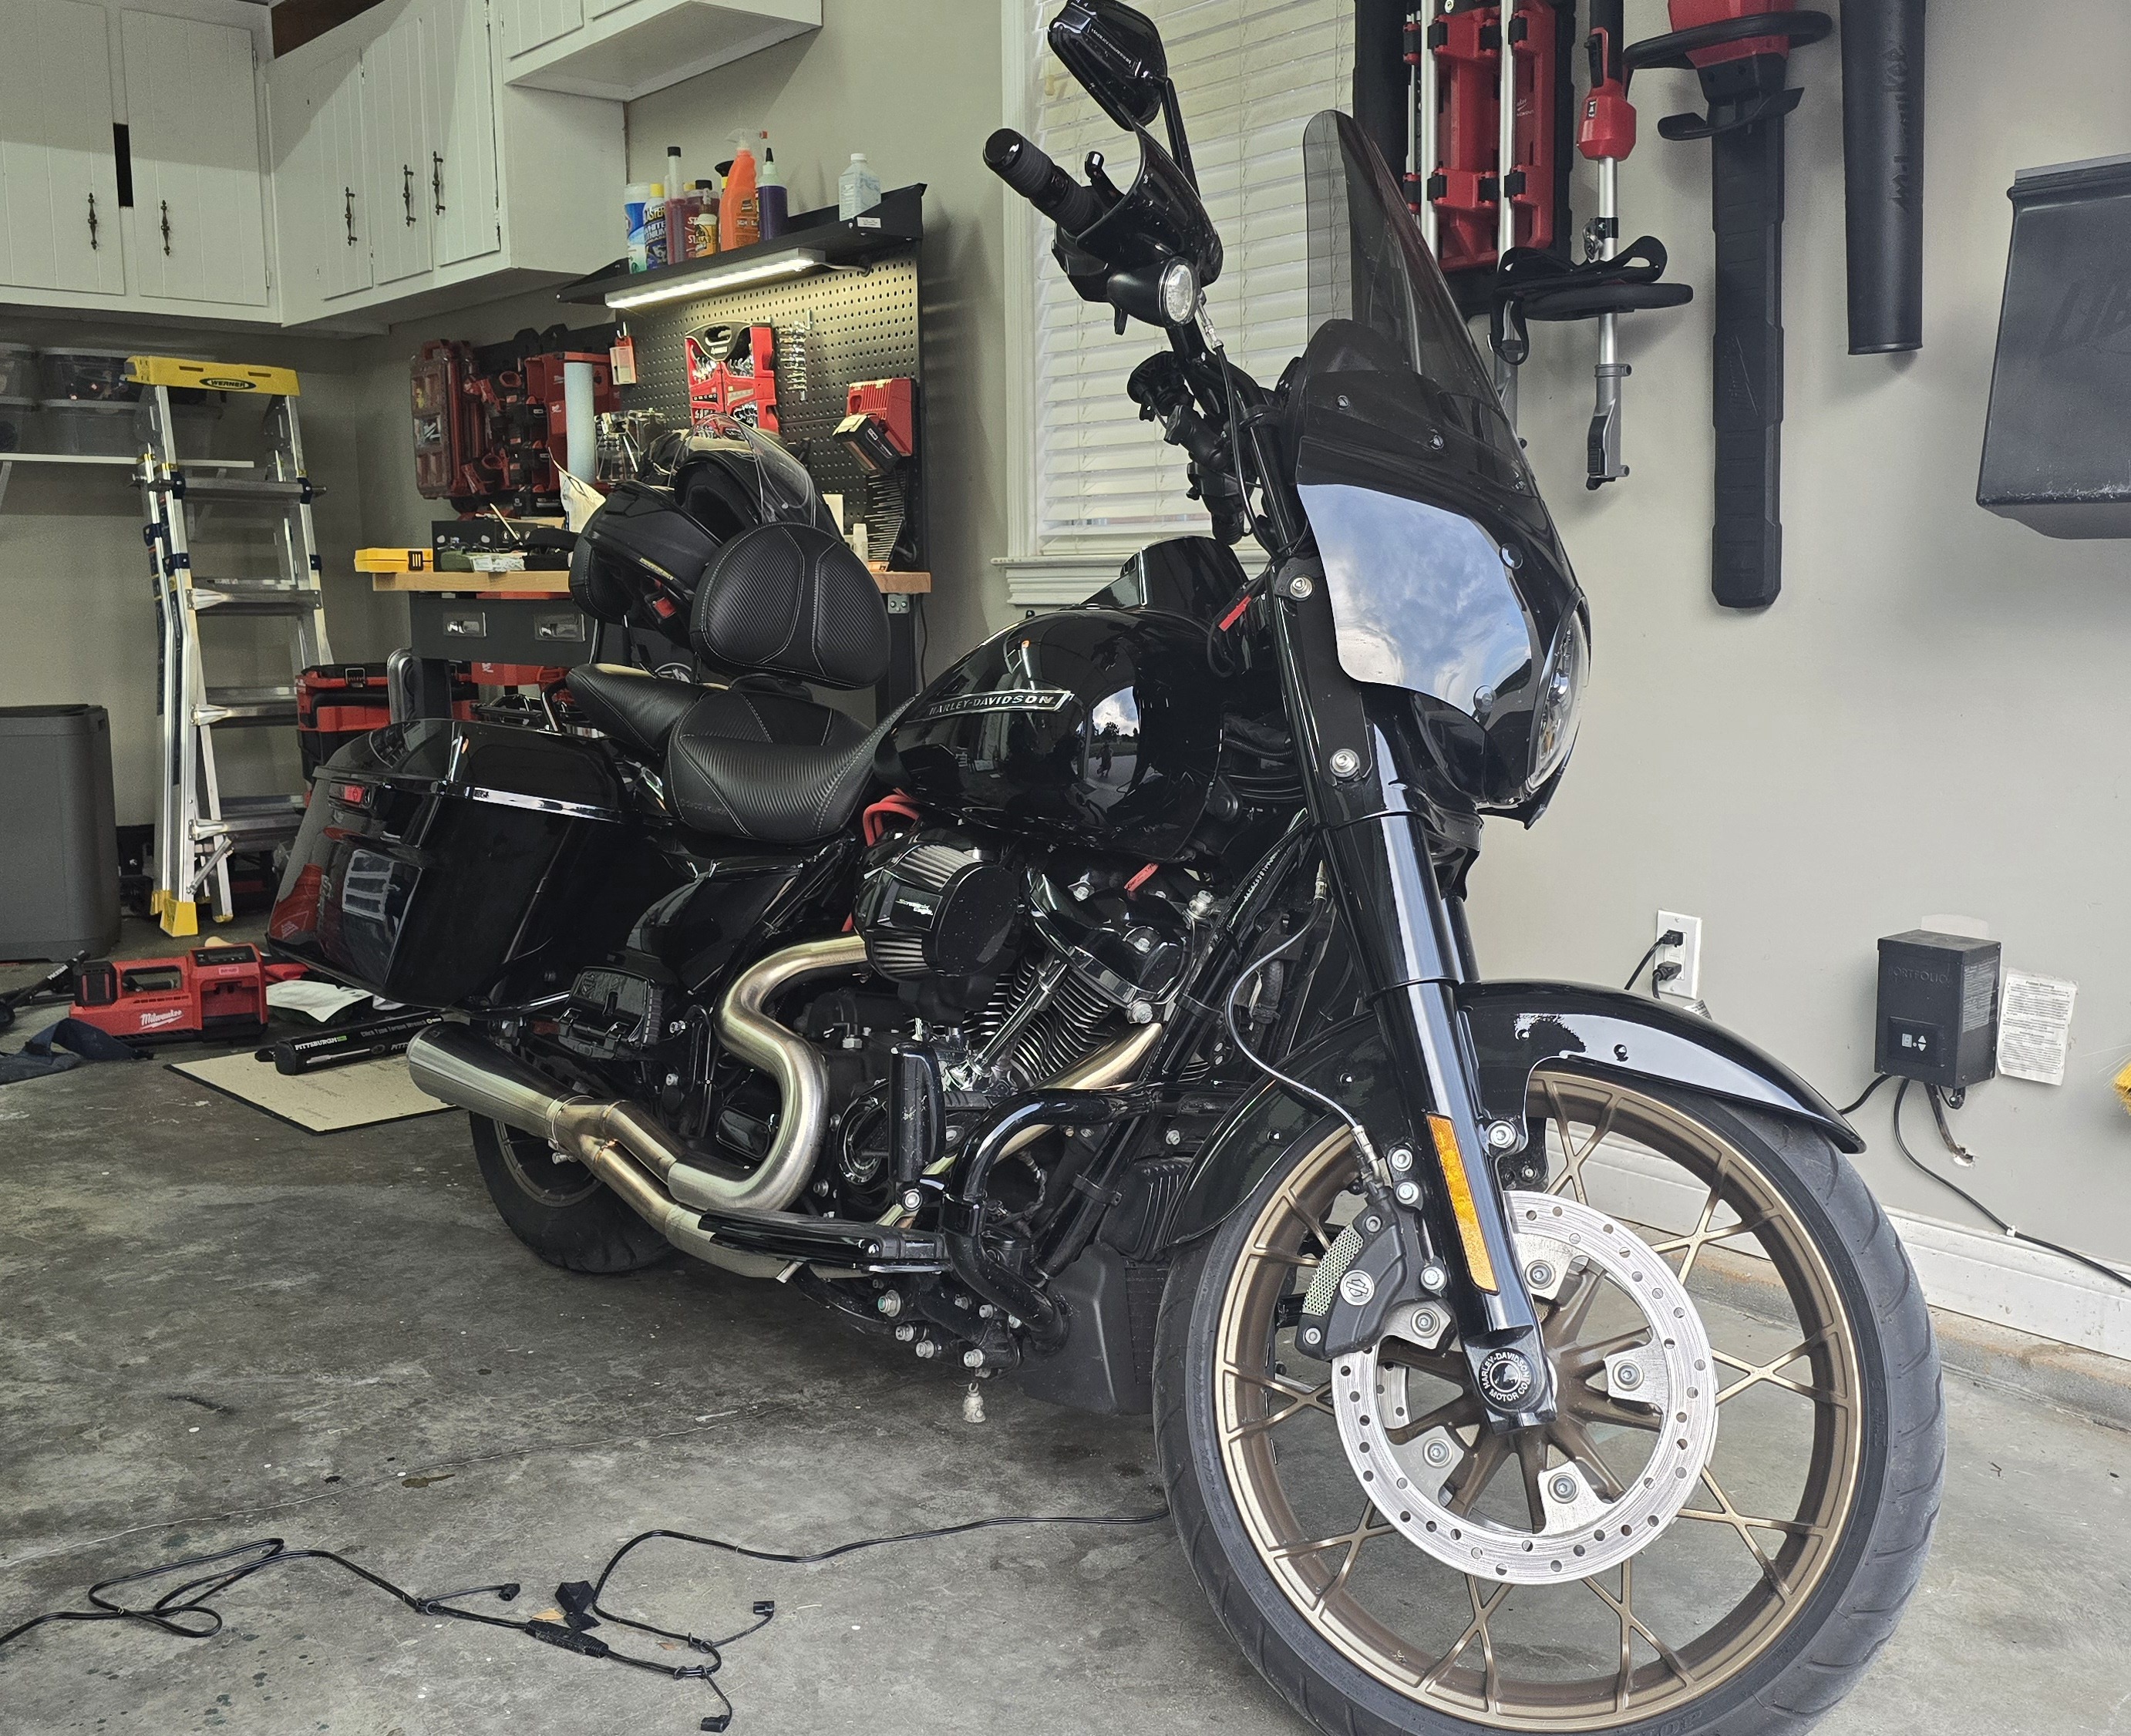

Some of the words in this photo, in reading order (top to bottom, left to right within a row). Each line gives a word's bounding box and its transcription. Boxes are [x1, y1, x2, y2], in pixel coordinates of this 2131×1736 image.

[928, 695, 1054, 715] HARLEY-DAVIDSON
[140, 1009, 183, 1027] Milwaukee
[295, 1037, 338, 1051] PITTSBURGH
[1481, 1351, 1531, 1389] HARLEY-DAVIDSON
[1489, 1388, 1520, 1402] MOTOR
